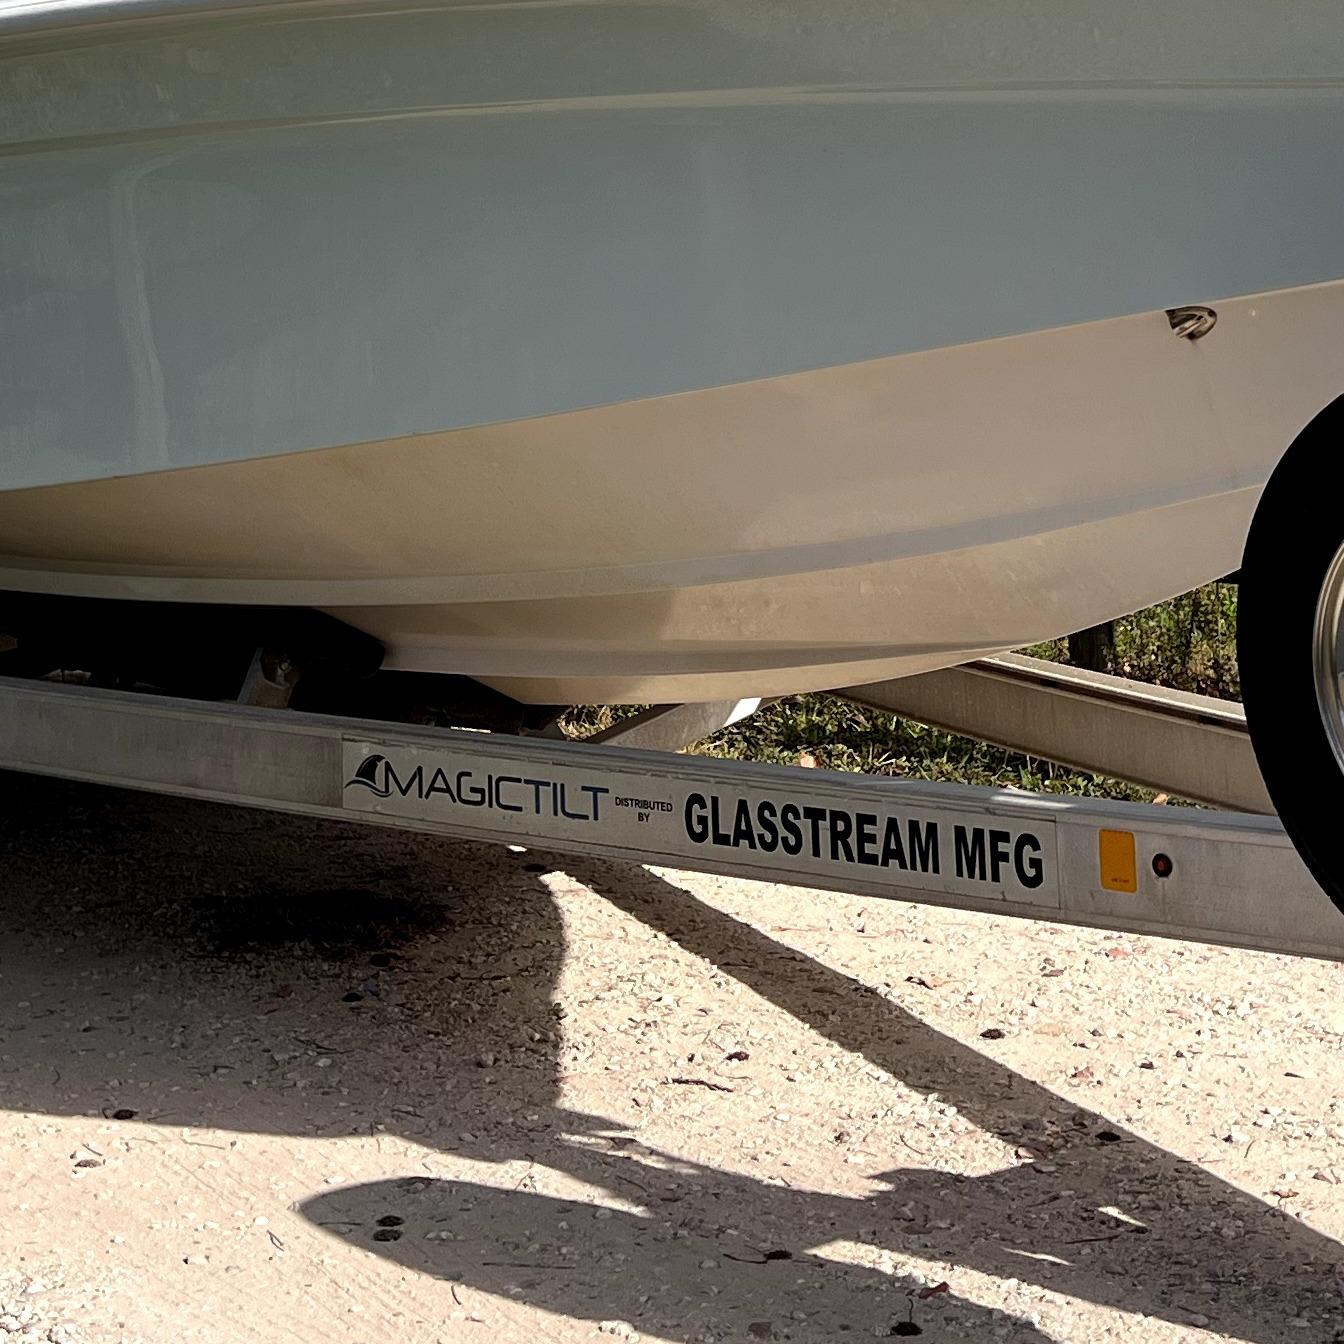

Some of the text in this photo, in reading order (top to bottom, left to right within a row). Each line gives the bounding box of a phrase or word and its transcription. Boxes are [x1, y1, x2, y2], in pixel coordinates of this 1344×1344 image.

[384, 759, 610, 821] MAGICTILT
[614, 796, 673, 813] DISTRIBUTED
[637, 811, 651, 823] BY
[684, 792, 1045, 890] GLASSTREAM MFG
